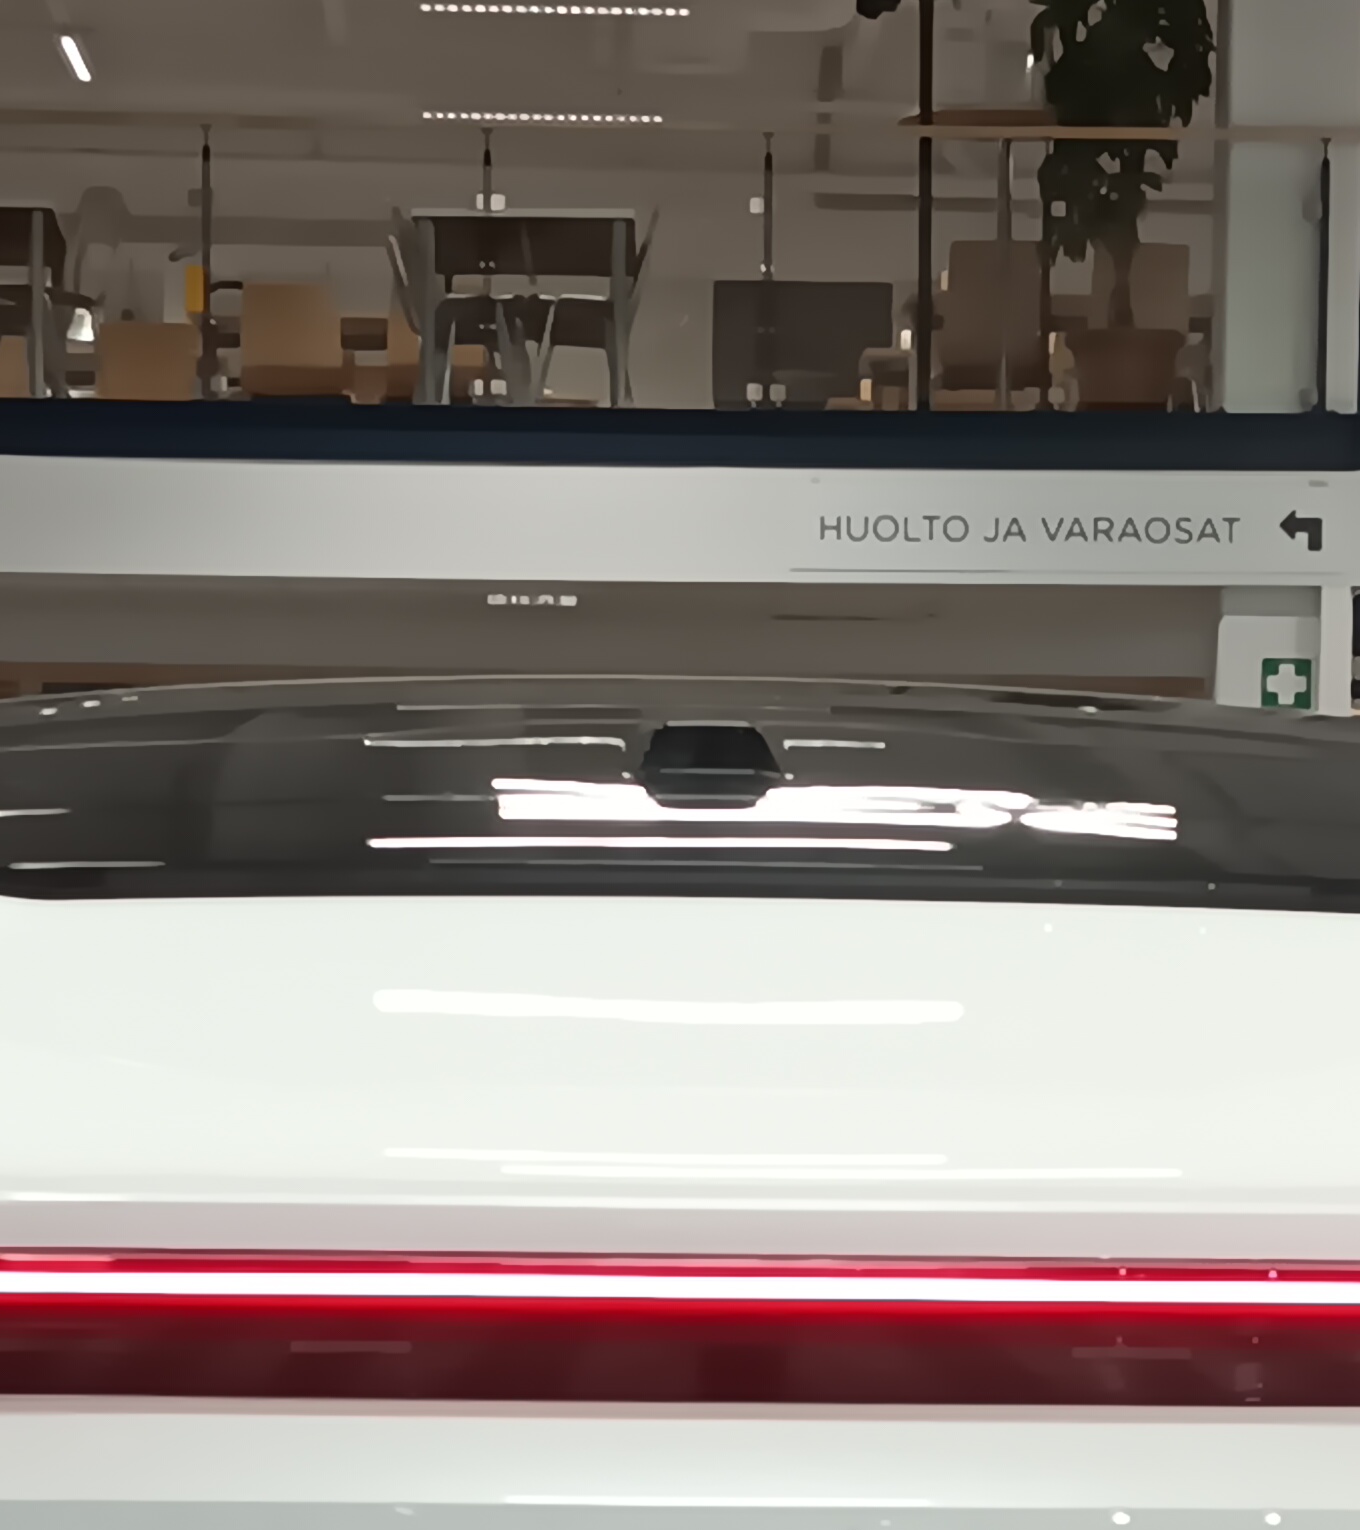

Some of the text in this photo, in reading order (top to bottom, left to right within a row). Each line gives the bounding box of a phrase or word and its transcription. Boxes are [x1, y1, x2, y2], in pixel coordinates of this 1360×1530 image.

[818, 514, 1241, 545] HUOLTO JA VARAOSAT
